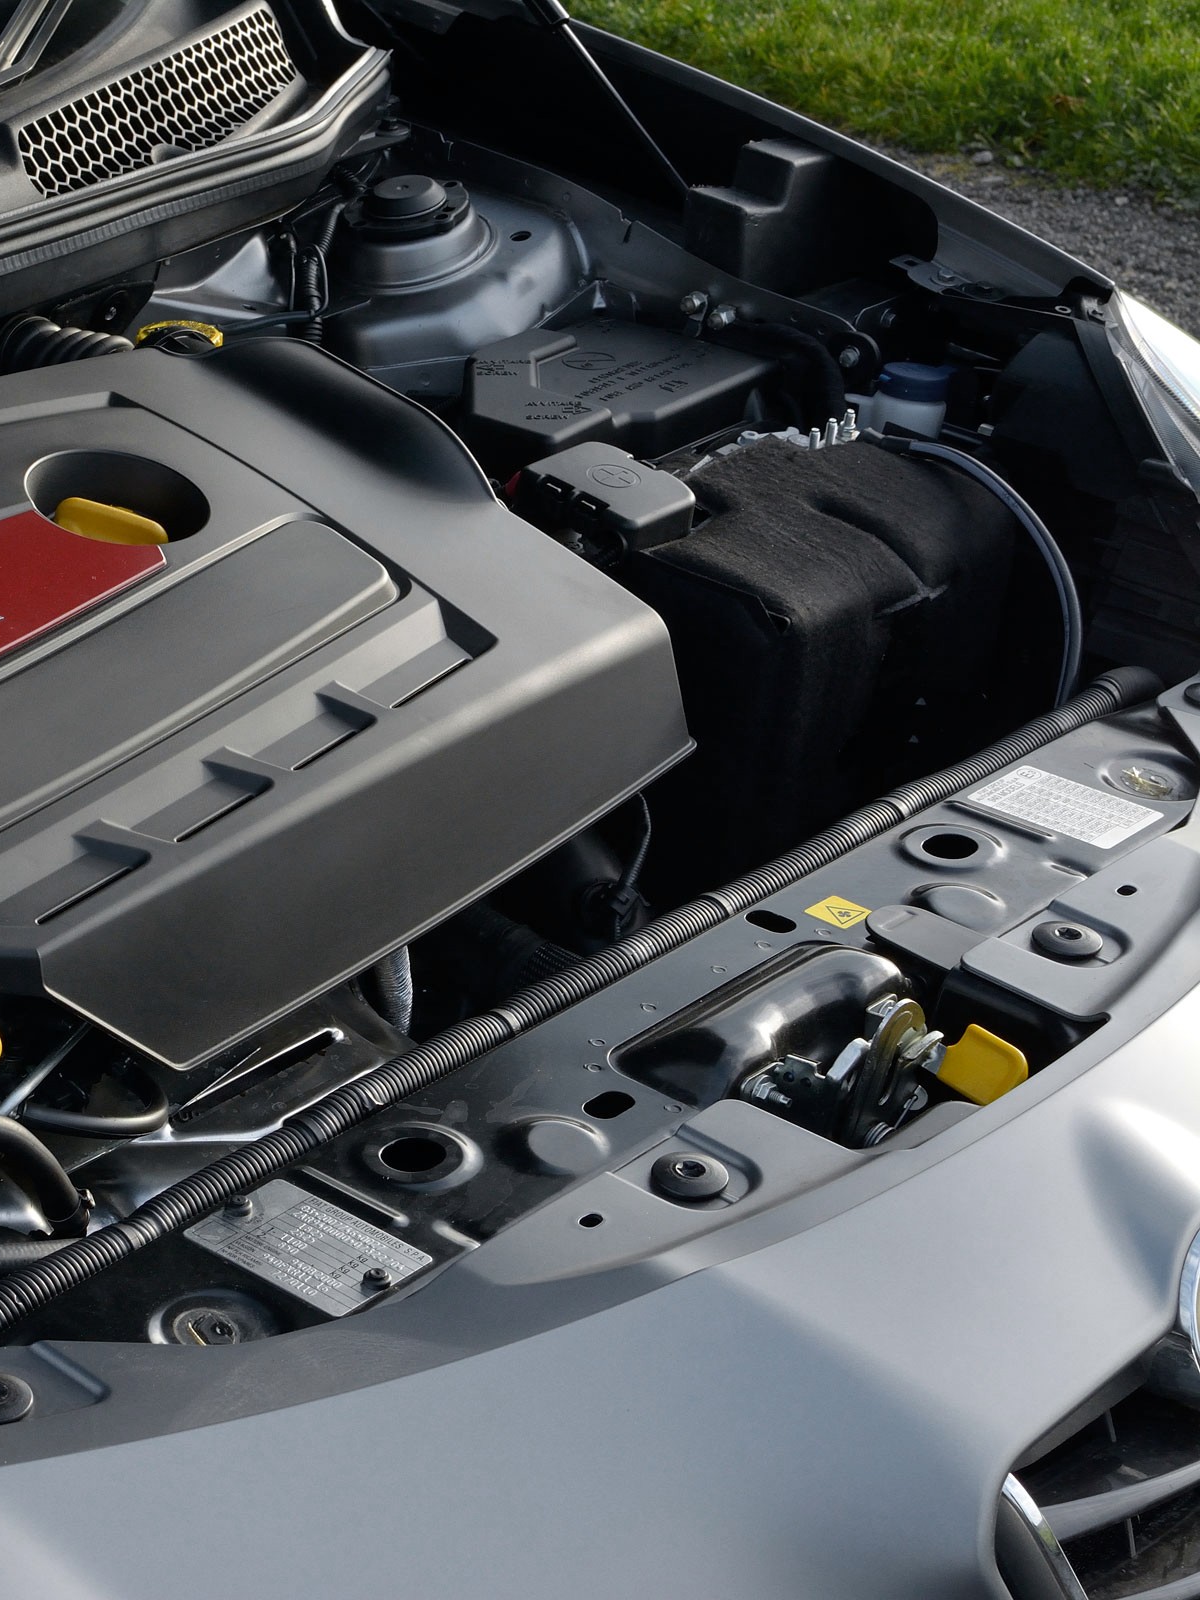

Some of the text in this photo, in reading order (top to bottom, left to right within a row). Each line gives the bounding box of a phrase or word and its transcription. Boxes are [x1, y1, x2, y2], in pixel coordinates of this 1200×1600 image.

[309, 1198, 325, 1209] FIAT
[325, 1206, 353, 1223] GROUP
[350, 1220, 404, 1249] AUTOMOBILES
[280, 1233, 308, 1249] 1100
